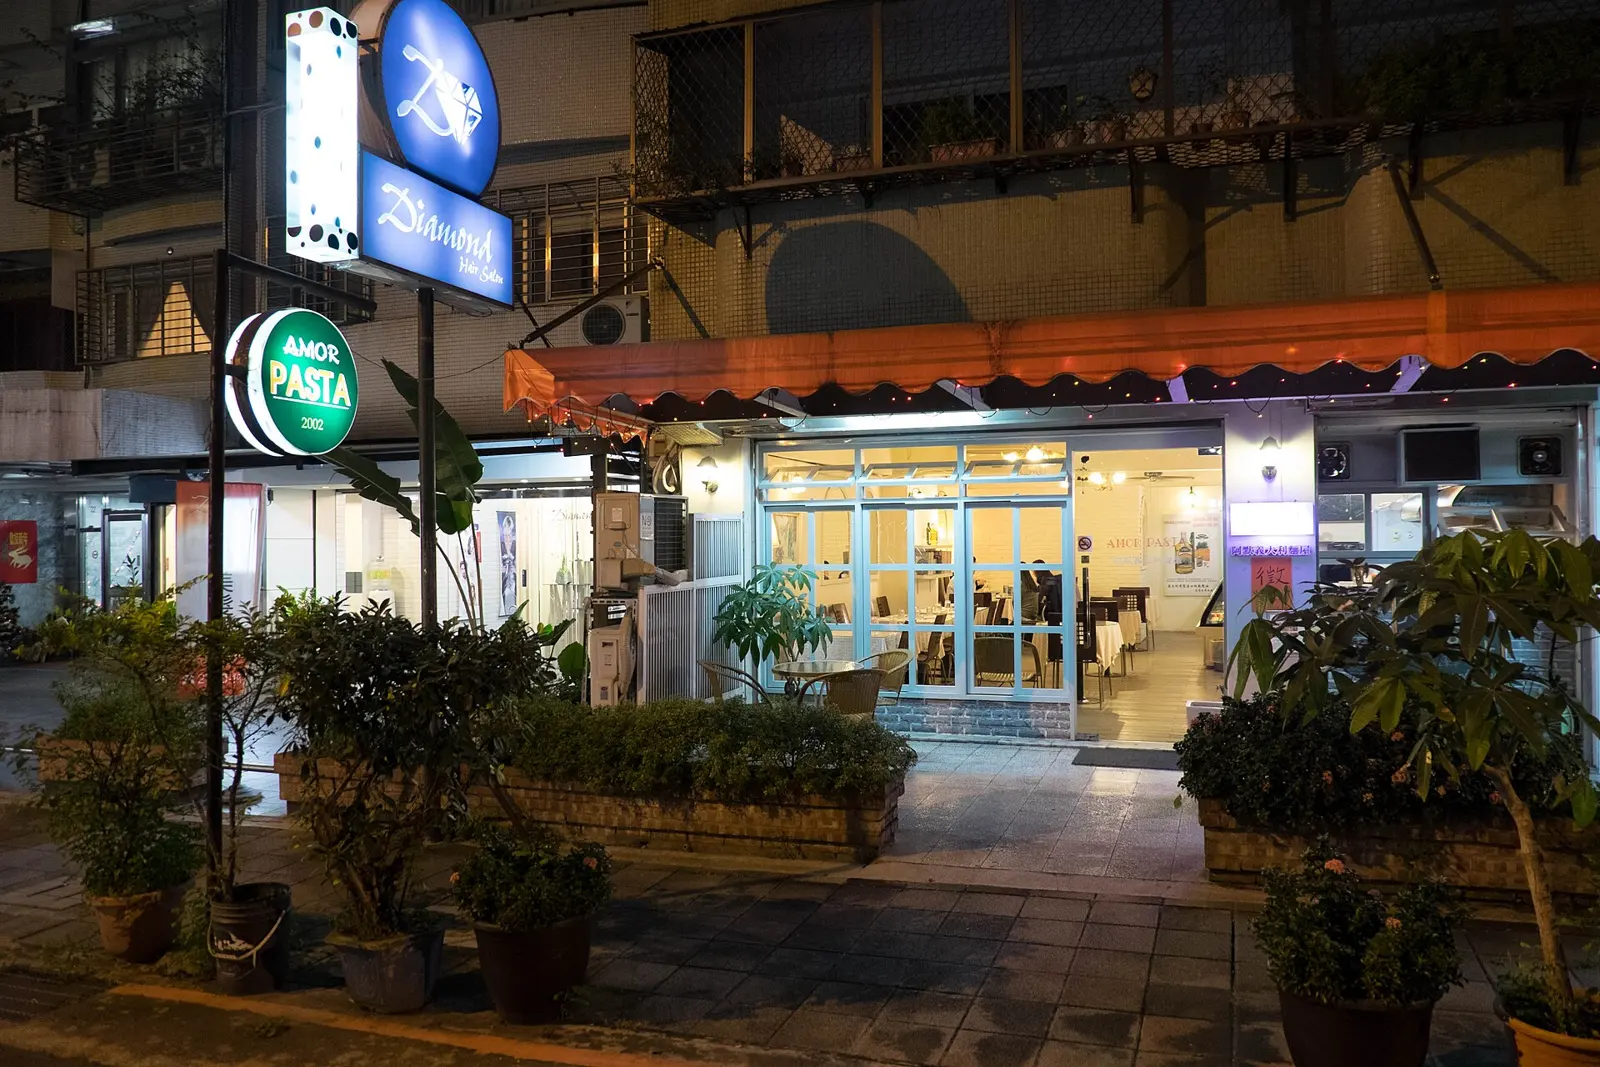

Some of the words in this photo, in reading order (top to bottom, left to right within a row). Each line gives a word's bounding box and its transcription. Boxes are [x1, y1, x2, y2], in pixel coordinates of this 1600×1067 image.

[377, 182, 493, 264] Diamond
[459, 256, 479, 275] Hair
[479, 265, 503, 285] Salon
[282, 334, 340, 365] AMOR
[269, 359, 352, 407] PASTA
[301, 416, 324, 431] 2002
[1146, 536, 1188, 548] PASTA
